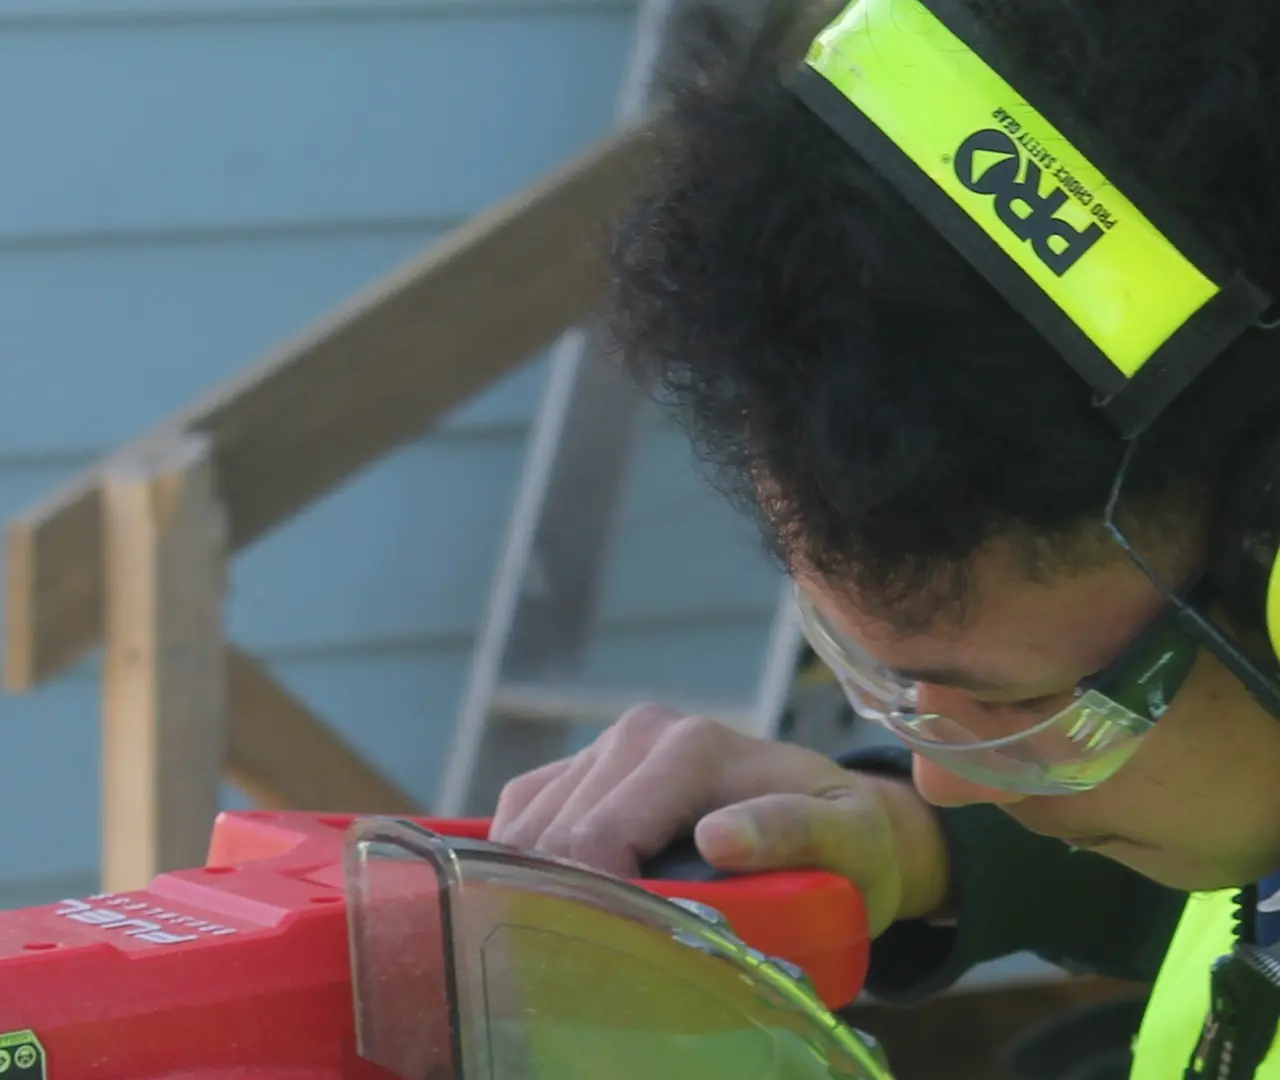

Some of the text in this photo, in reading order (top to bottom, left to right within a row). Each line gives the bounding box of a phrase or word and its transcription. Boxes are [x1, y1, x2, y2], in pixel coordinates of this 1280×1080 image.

[954, 128, 1105, 278] PRO
[991, 106, 1118, 230] PRO CHOICE SAFETY GEAR
